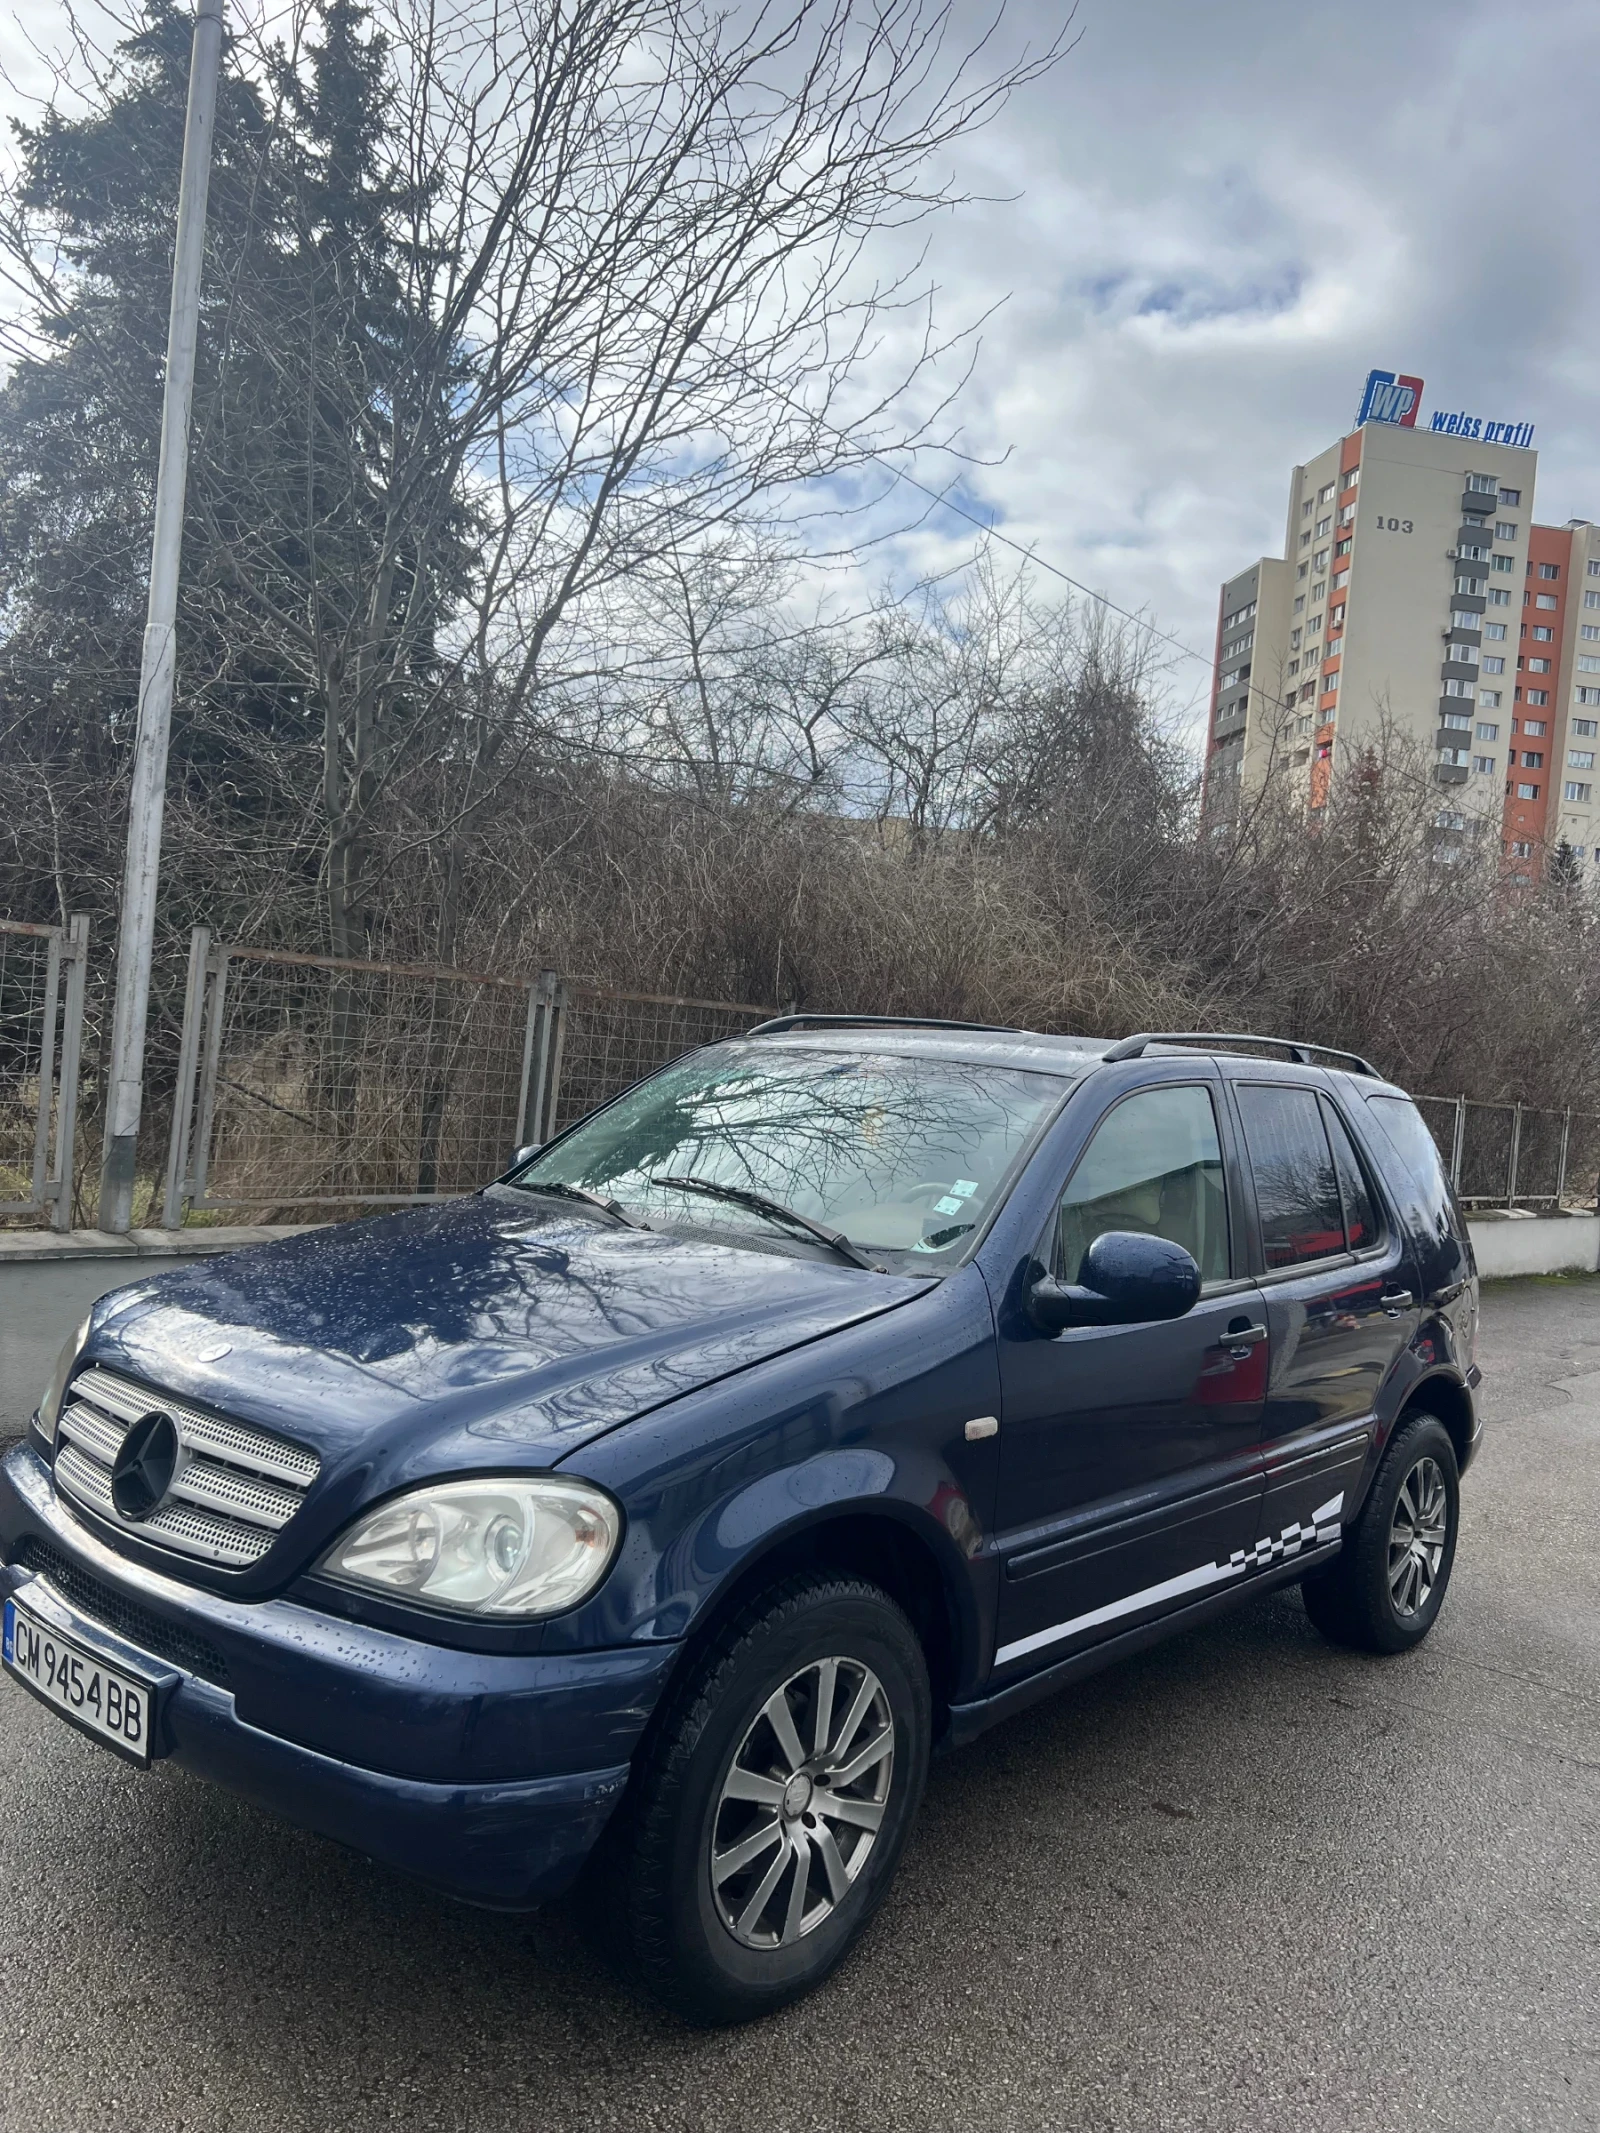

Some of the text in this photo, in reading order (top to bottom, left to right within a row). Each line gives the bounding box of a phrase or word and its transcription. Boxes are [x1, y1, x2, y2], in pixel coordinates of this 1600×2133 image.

[1369, 383, 1416, 425] WP
[1432, 411, 1535, 448] weiss profil
[1376, 516, 1414, 534] 103
